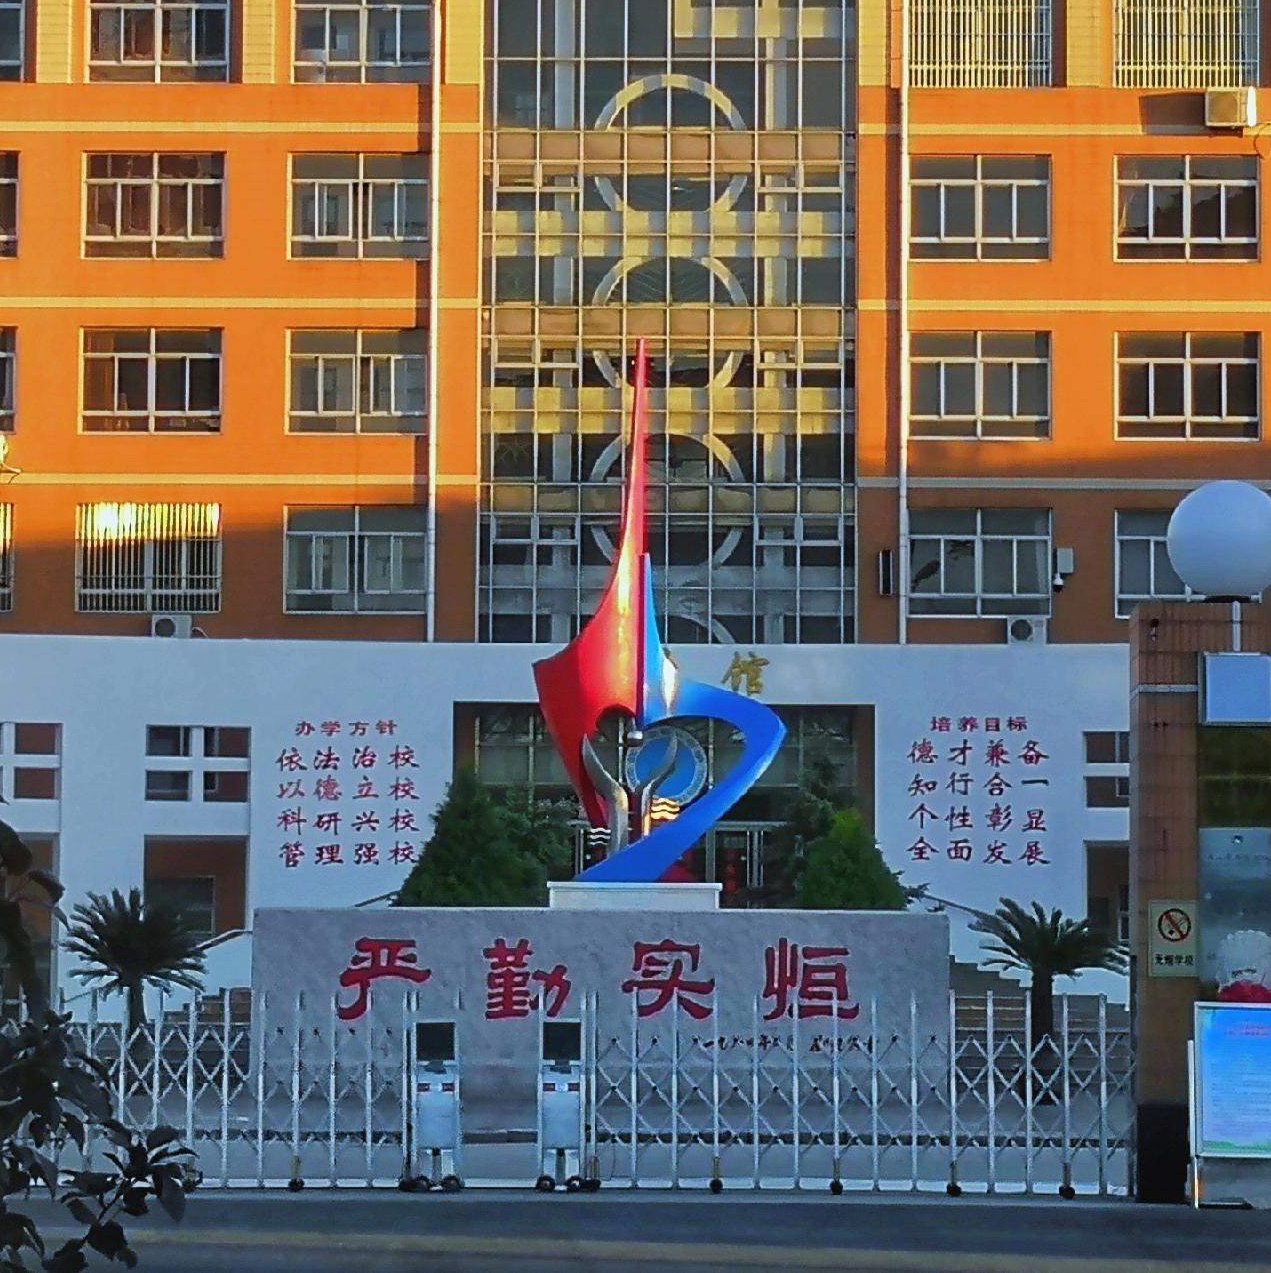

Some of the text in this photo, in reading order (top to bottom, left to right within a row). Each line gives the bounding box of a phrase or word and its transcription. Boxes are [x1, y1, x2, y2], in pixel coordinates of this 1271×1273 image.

[294, 719, 398, 737] 办学方针
[930, 715, 1028, 733] 培养目标
[274, 744, 421, 772] 依法治校
[906, 738, 1050, 768] 德才兼备
[275, 774, 421, 802] 以德立校
[907, 771, 1050, 797] 知行合一
[276, 806, 421, 836] 科研兴校
[907, 802, 1049, 833] 个性彰显
[277, 840, 421, 869] 管理强校
[906, 835, 1052, 867] 全面发展
[337, 936, 861, 1021] 严勤实恒
